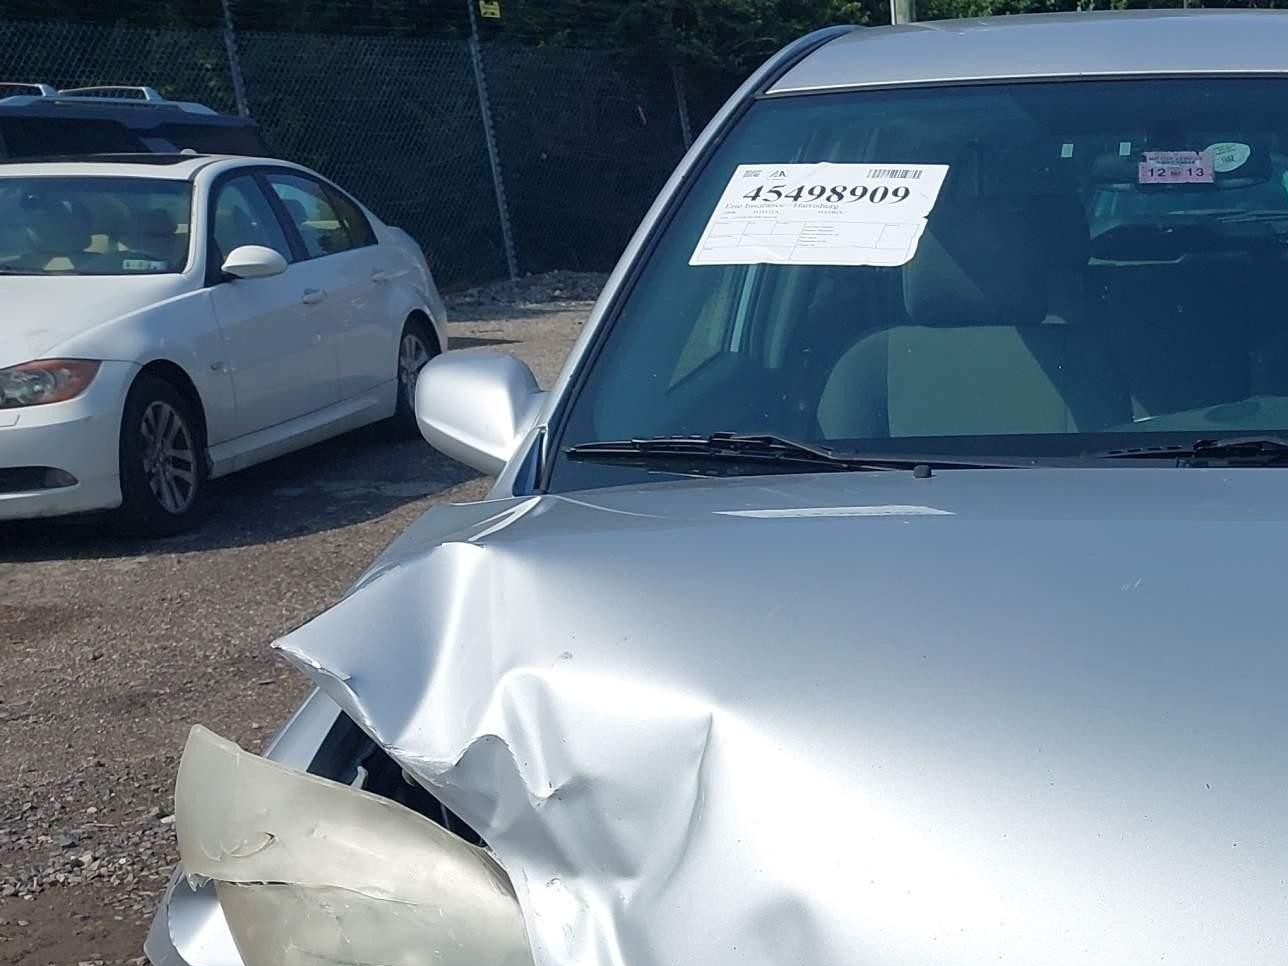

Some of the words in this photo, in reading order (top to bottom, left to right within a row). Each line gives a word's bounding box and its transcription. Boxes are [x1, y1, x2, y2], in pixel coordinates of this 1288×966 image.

[1149, 168, 1166, 177] 12
[1188, 168, 1204, 177] 13
[742, 184, 910, 204] 45498909
